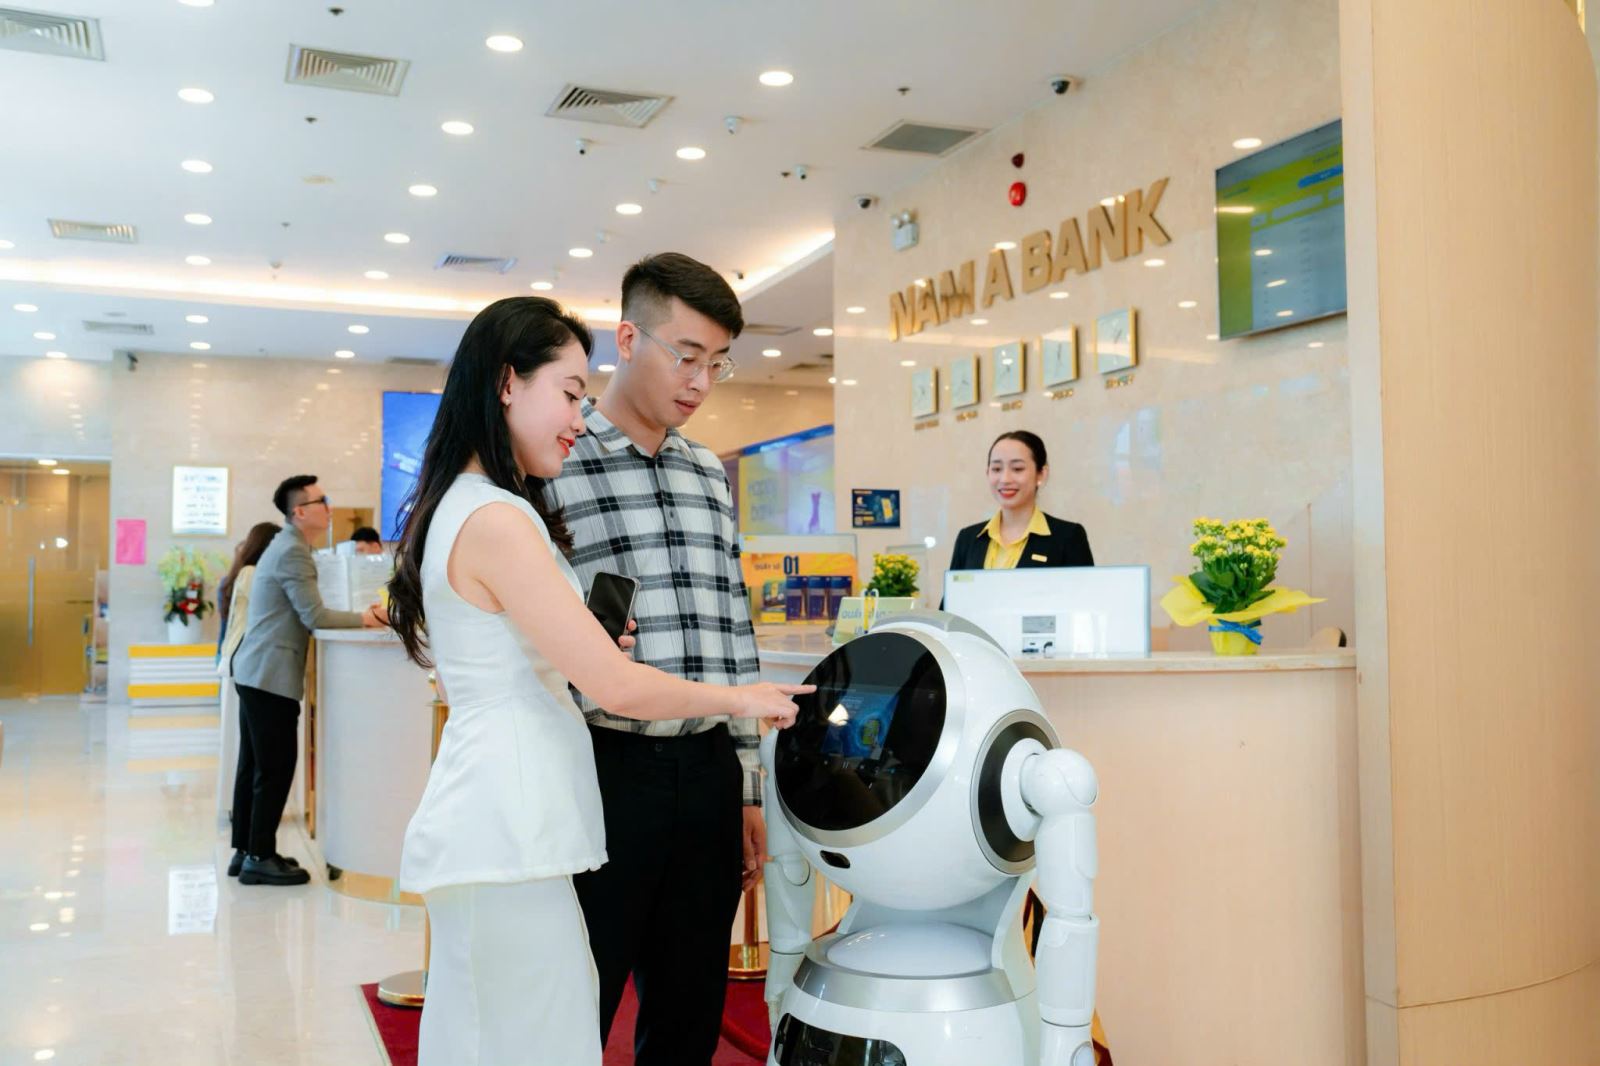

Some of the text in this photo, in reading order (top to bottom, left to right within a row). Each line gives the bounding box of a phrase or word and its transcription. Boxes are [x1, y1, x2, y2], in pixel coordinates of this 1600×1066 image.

[889, 177, 1172, 342] NAM A BANK
[783, 555, 799, 575] 01
